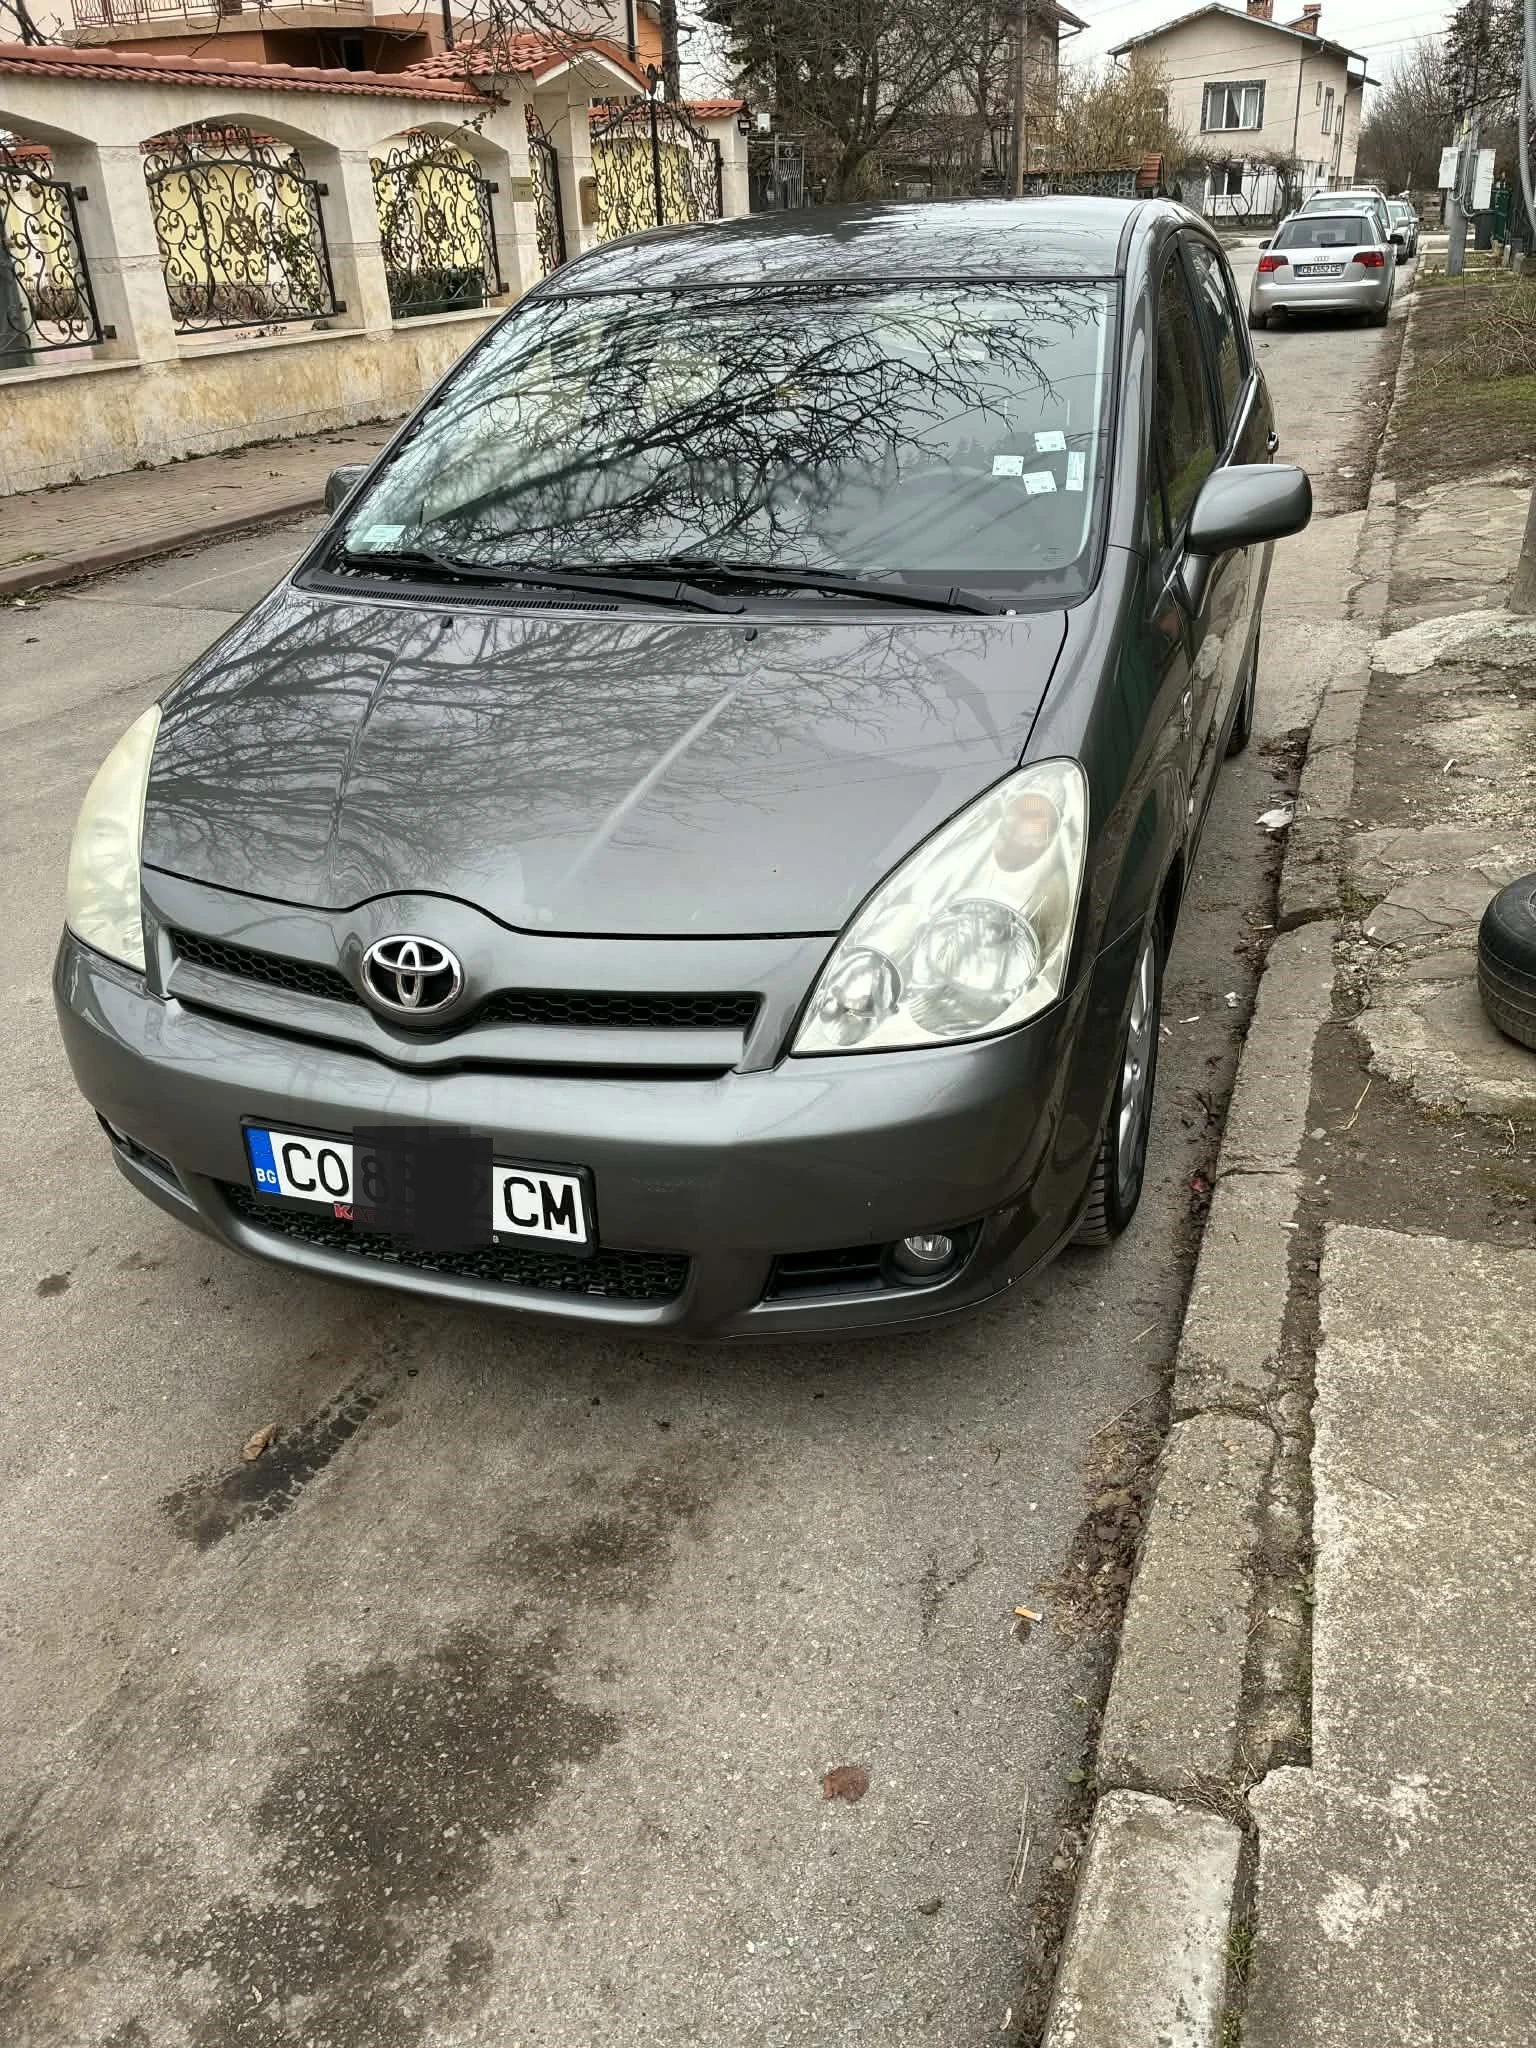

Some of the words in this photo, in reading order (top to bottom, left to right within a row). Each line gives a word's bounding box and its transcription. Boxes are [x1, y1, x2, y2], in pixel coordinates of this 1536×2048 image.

[256, 1168, 277, 1185] BG
[281, 1142, 349, 1197] CO
[503, 1176, 578, 1234] CM
